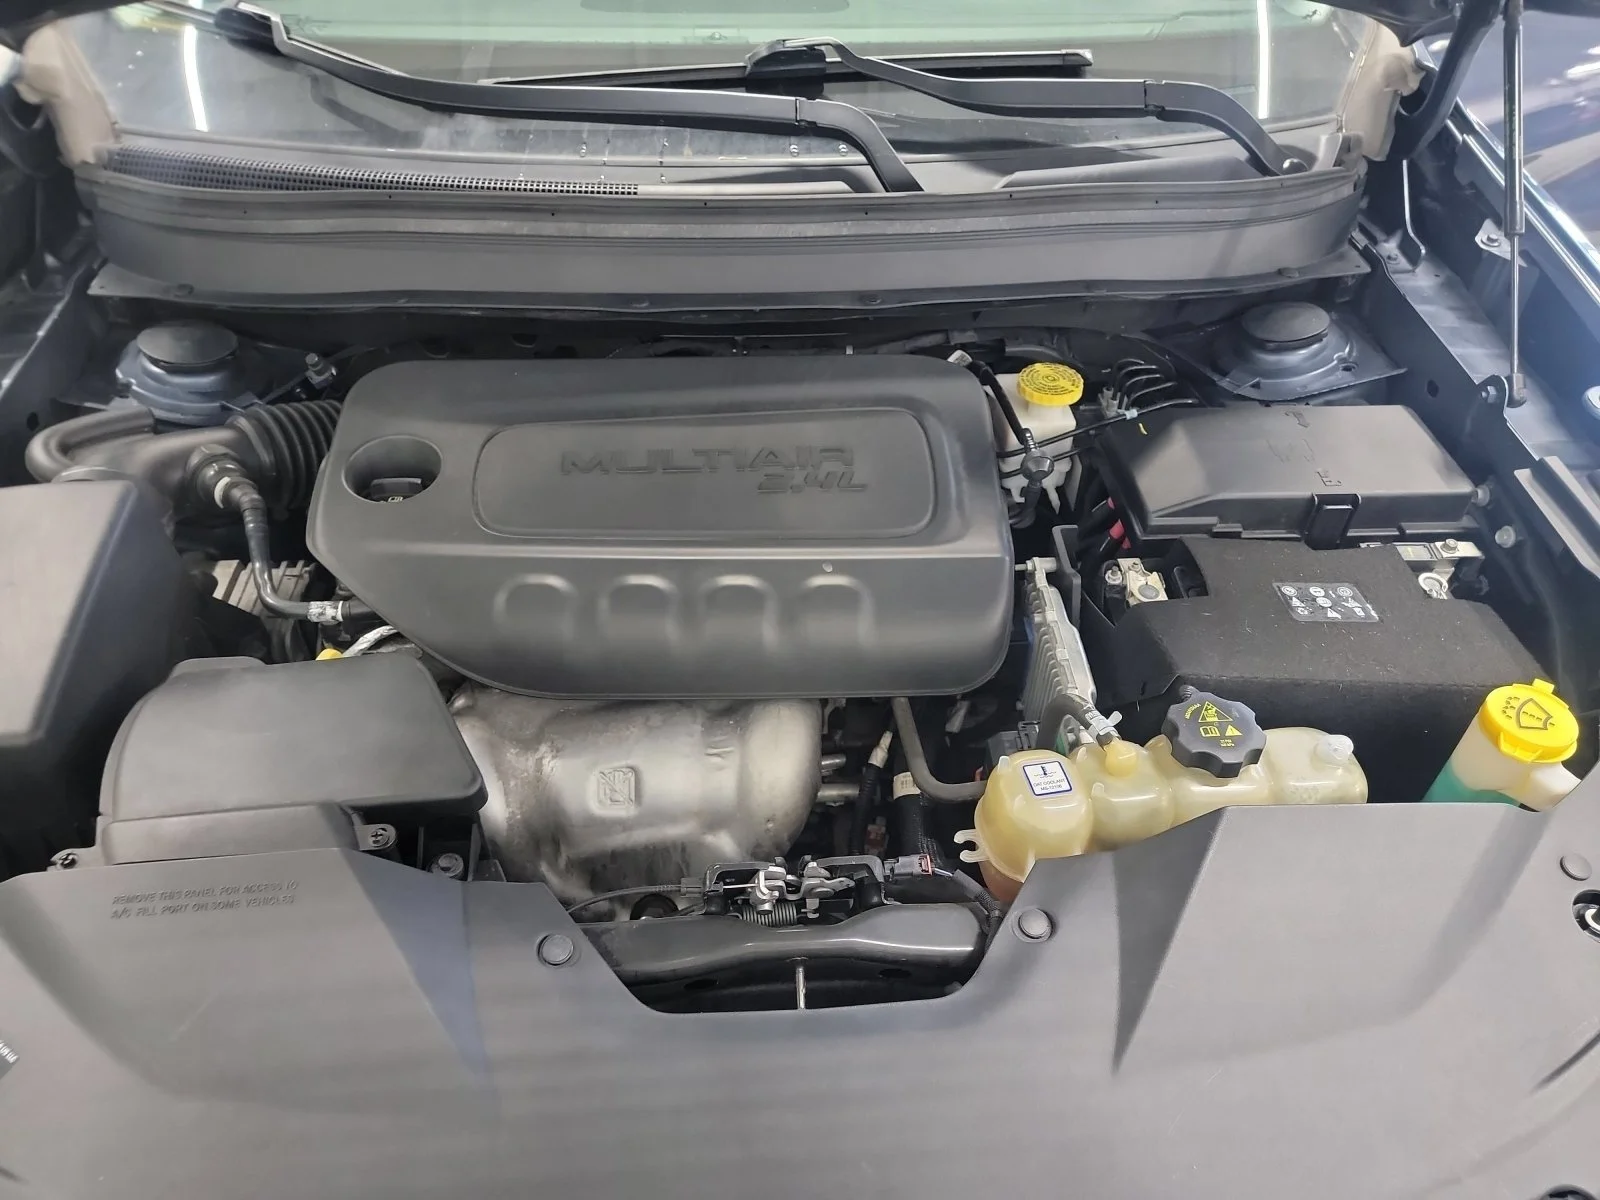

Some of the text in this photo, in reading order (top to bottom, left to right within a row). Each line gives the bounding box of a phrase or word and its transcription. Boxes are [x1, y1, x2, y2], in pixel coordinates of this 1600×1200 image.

[560, 446, 855, 475] MULTIAIR
[757, 470, 868, 495] 2.4L
[112, 891, 156, 905] REMOVE
[158, 888, 183, 901] THIS
[183, 887, 216, 899] PANEL
[217, 884, 241, 897] FOR
[241, 881, 283, 895] ACCESS
[135, 905, 158, 918] FILL
[160, 902, 190, 916] PORT
[191, 901, 209, 913] ON
[209, 898, 241, 911] SOME
[245, 894, 296, 909] VEHICLES
